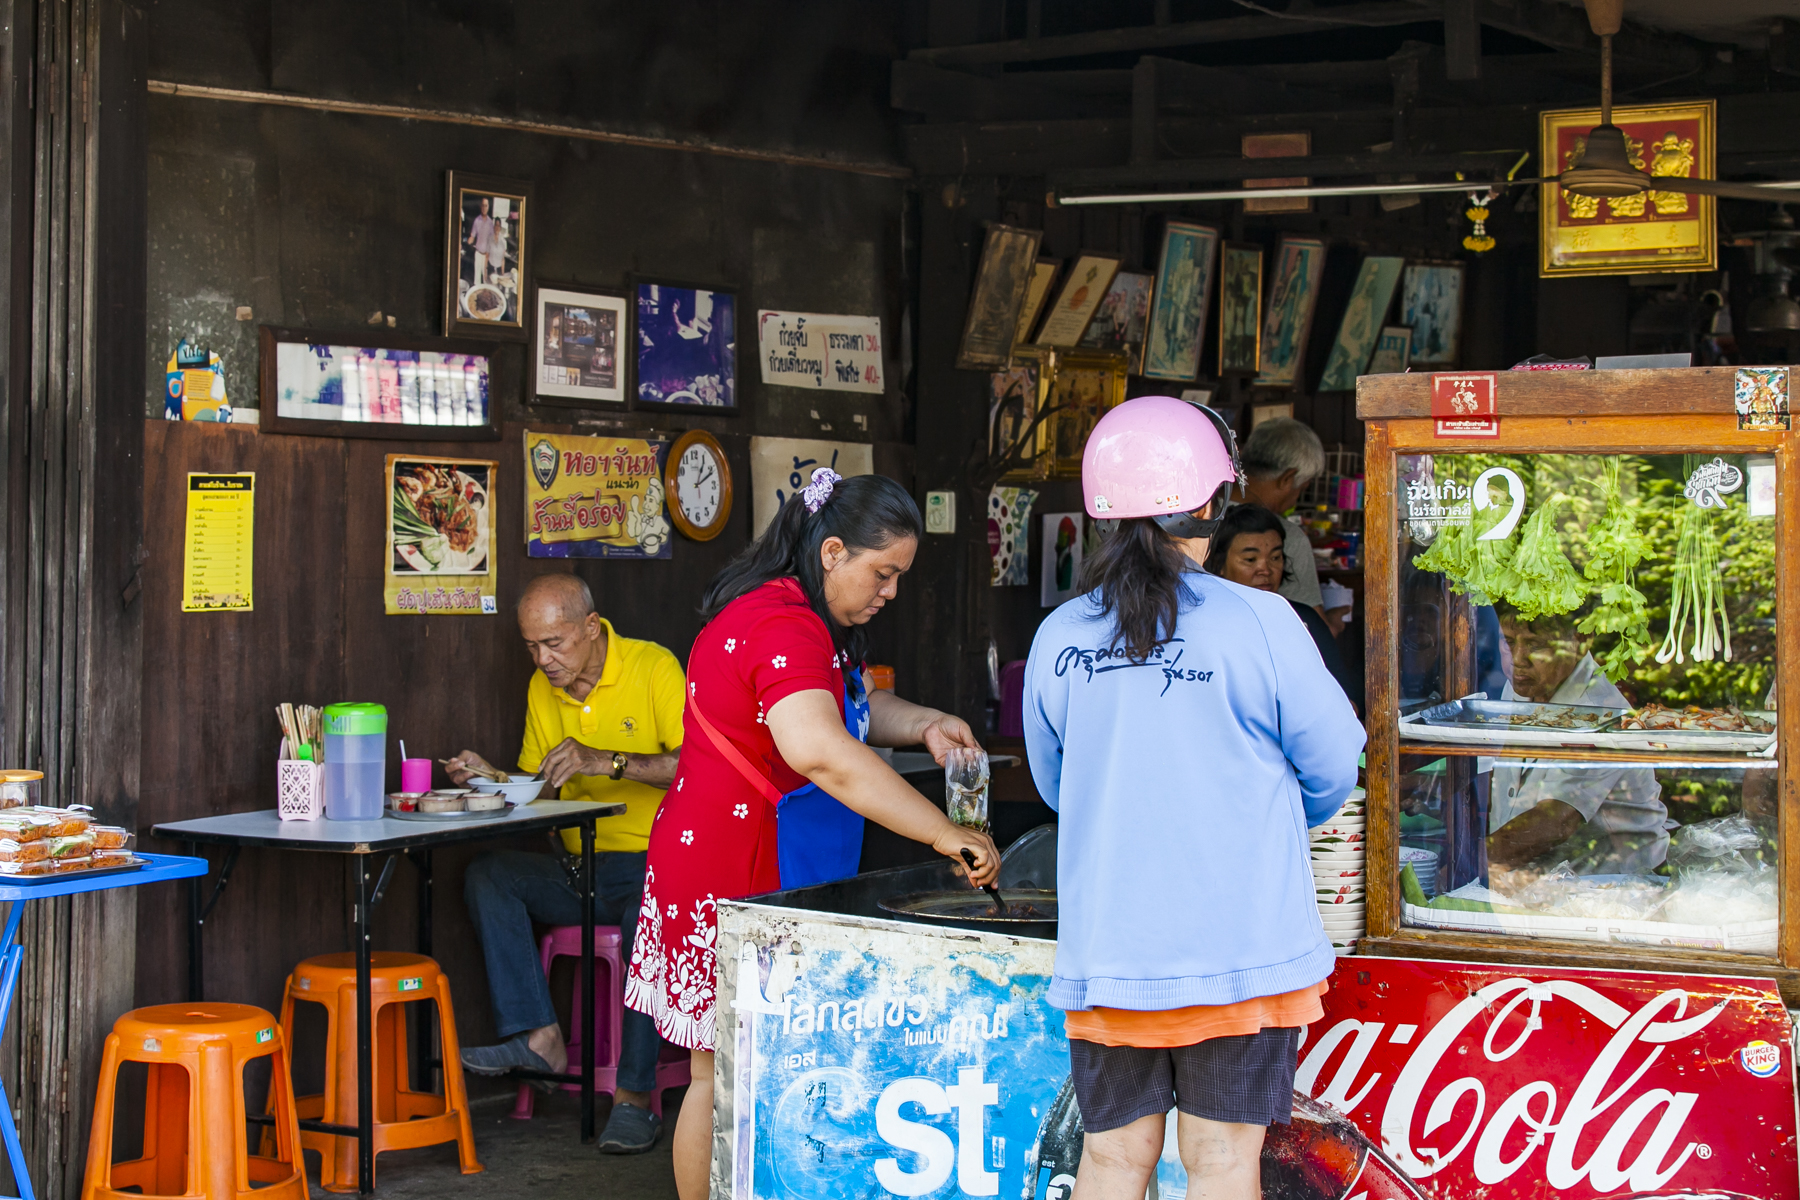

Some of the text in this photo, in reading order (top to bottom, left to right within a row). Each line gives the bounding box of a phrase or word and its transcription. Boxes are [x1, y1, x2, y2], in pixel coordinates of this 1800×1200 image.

[829, 333, 864, 351] ธรรมดา
[835, 359, 860, 383] พิเศษ
[563, 444, 660, 475] หอฯจันท์
[606, 477, 640, 489] แนะนำ
[1406, 479, 1472, 500] ฉันเกิด
[695, 512, 700, 522] 6
[1745, 1045, 1776, 1057] BURGER
[1747, 1053, 1776, 1067] KING
[874, 1068, 999, 1197] st
[1042, 1160, 1056, 1169] est
